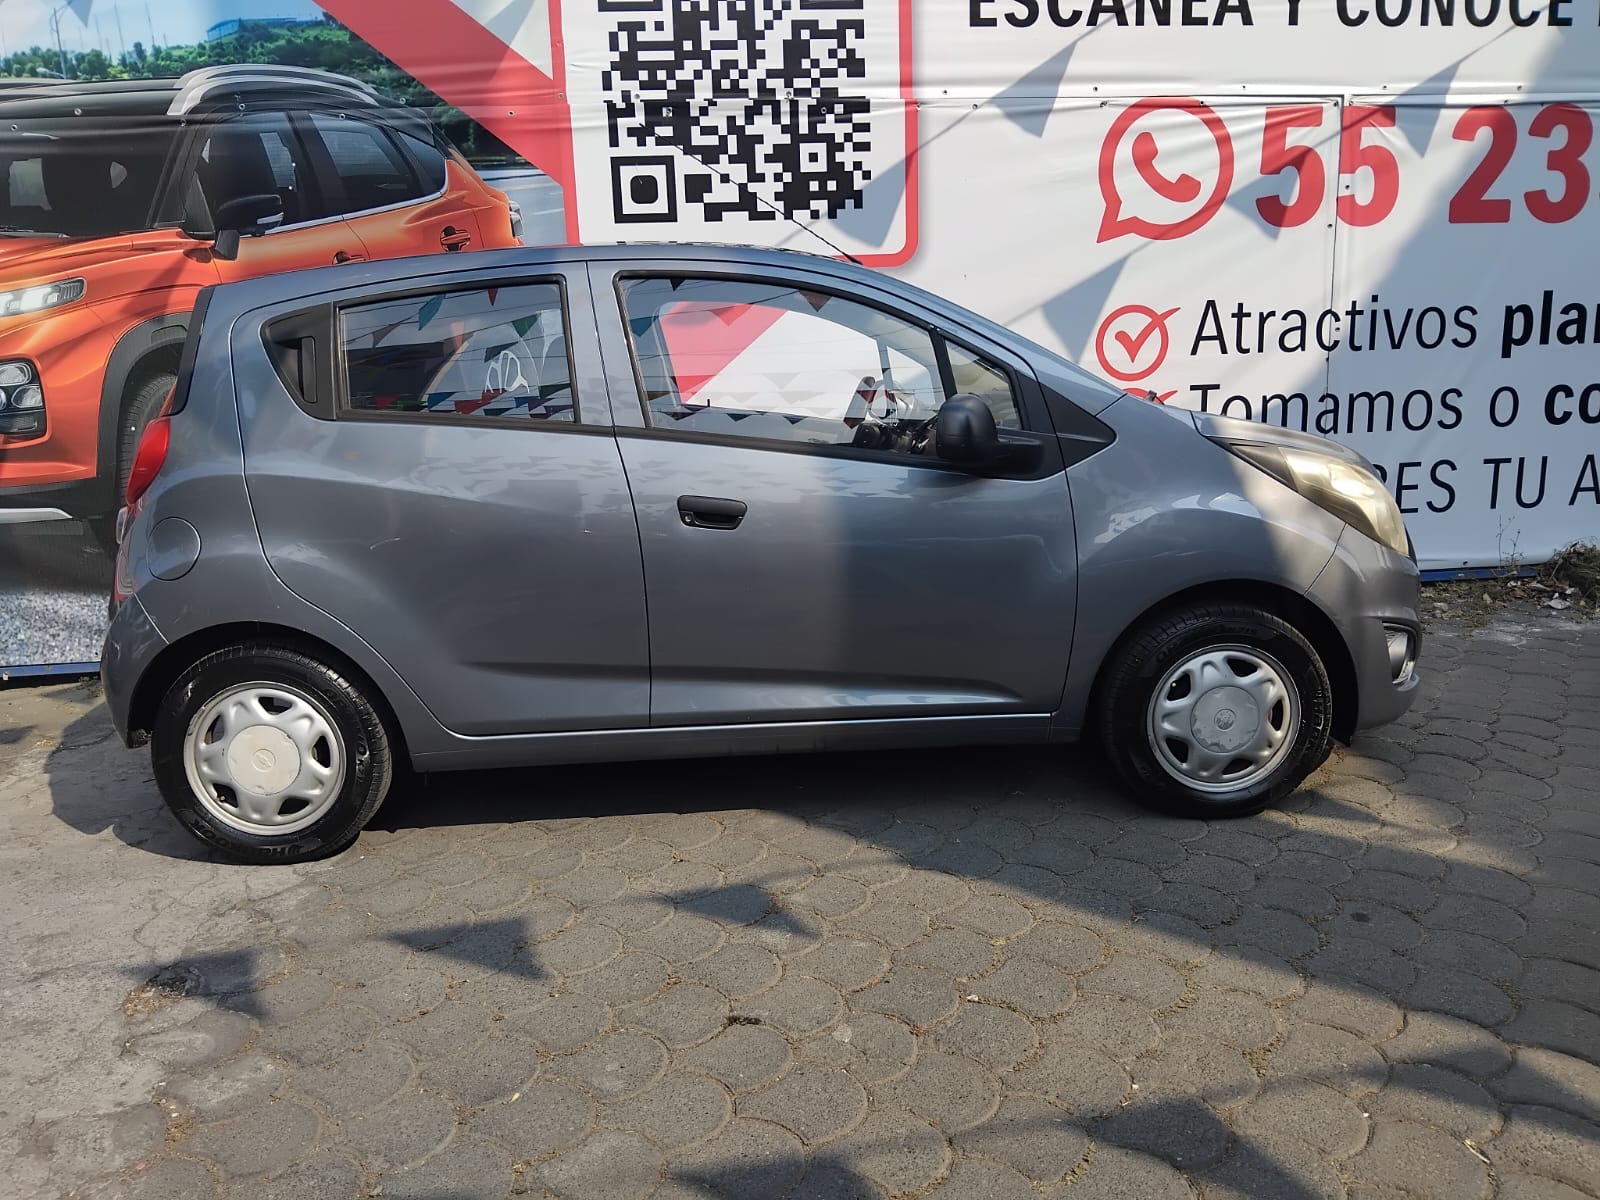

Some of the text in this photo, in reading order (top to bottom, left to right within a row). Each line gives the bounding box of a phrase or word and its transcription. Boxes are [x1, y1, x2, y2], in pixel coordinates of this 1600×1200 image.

[1336, 0, 1573, 28] CONOCE
[1256, 103, 1593, 228] 55 23
[1190, 290, 1600, 359] Atractivos pla
[1189, 383, 1463, 435] Tomamos
[1489, 386, 1519, 428] o
[1483, 455, 1548, 510] TU
[1568, 454, 1600, 506] A
